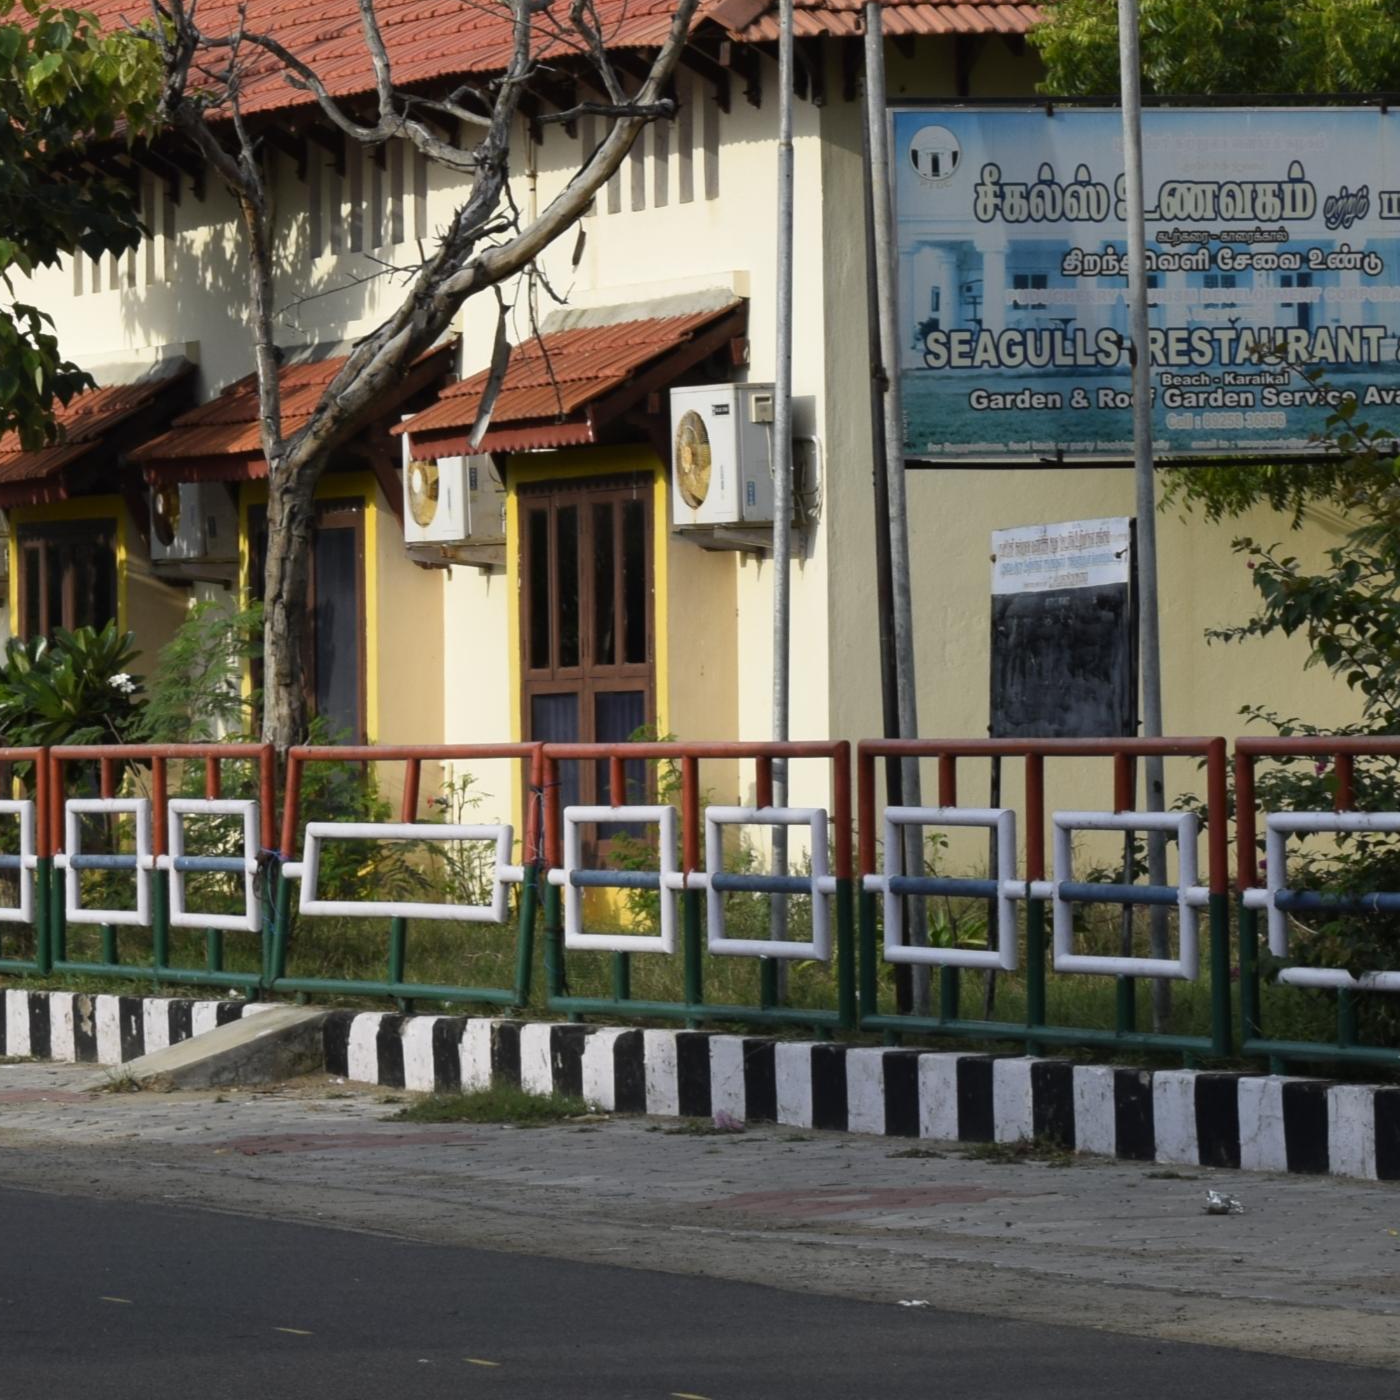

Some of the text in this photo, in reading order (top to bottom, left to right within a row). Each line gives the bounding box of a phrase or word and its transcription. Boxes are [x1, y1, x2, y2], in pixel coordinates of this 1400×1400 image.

[1216, 246, 1302, 272] சேவை
[1307, 243, 1383, 277] உண்டு
[924, 328, 1121, 369] SEAGULLS
[1149, 326, 1387, 367] RESTAURANT
[1160, 371, 1211, 387] Beach
[1222, 370, 1290, 387] Karaikal
[969, 387, 1062, 411] Garden
[1069, 388, 1091, 410] &
[1097, 387, 1156, 409] Rof
[1163, 386, 1255, 410] Garden
